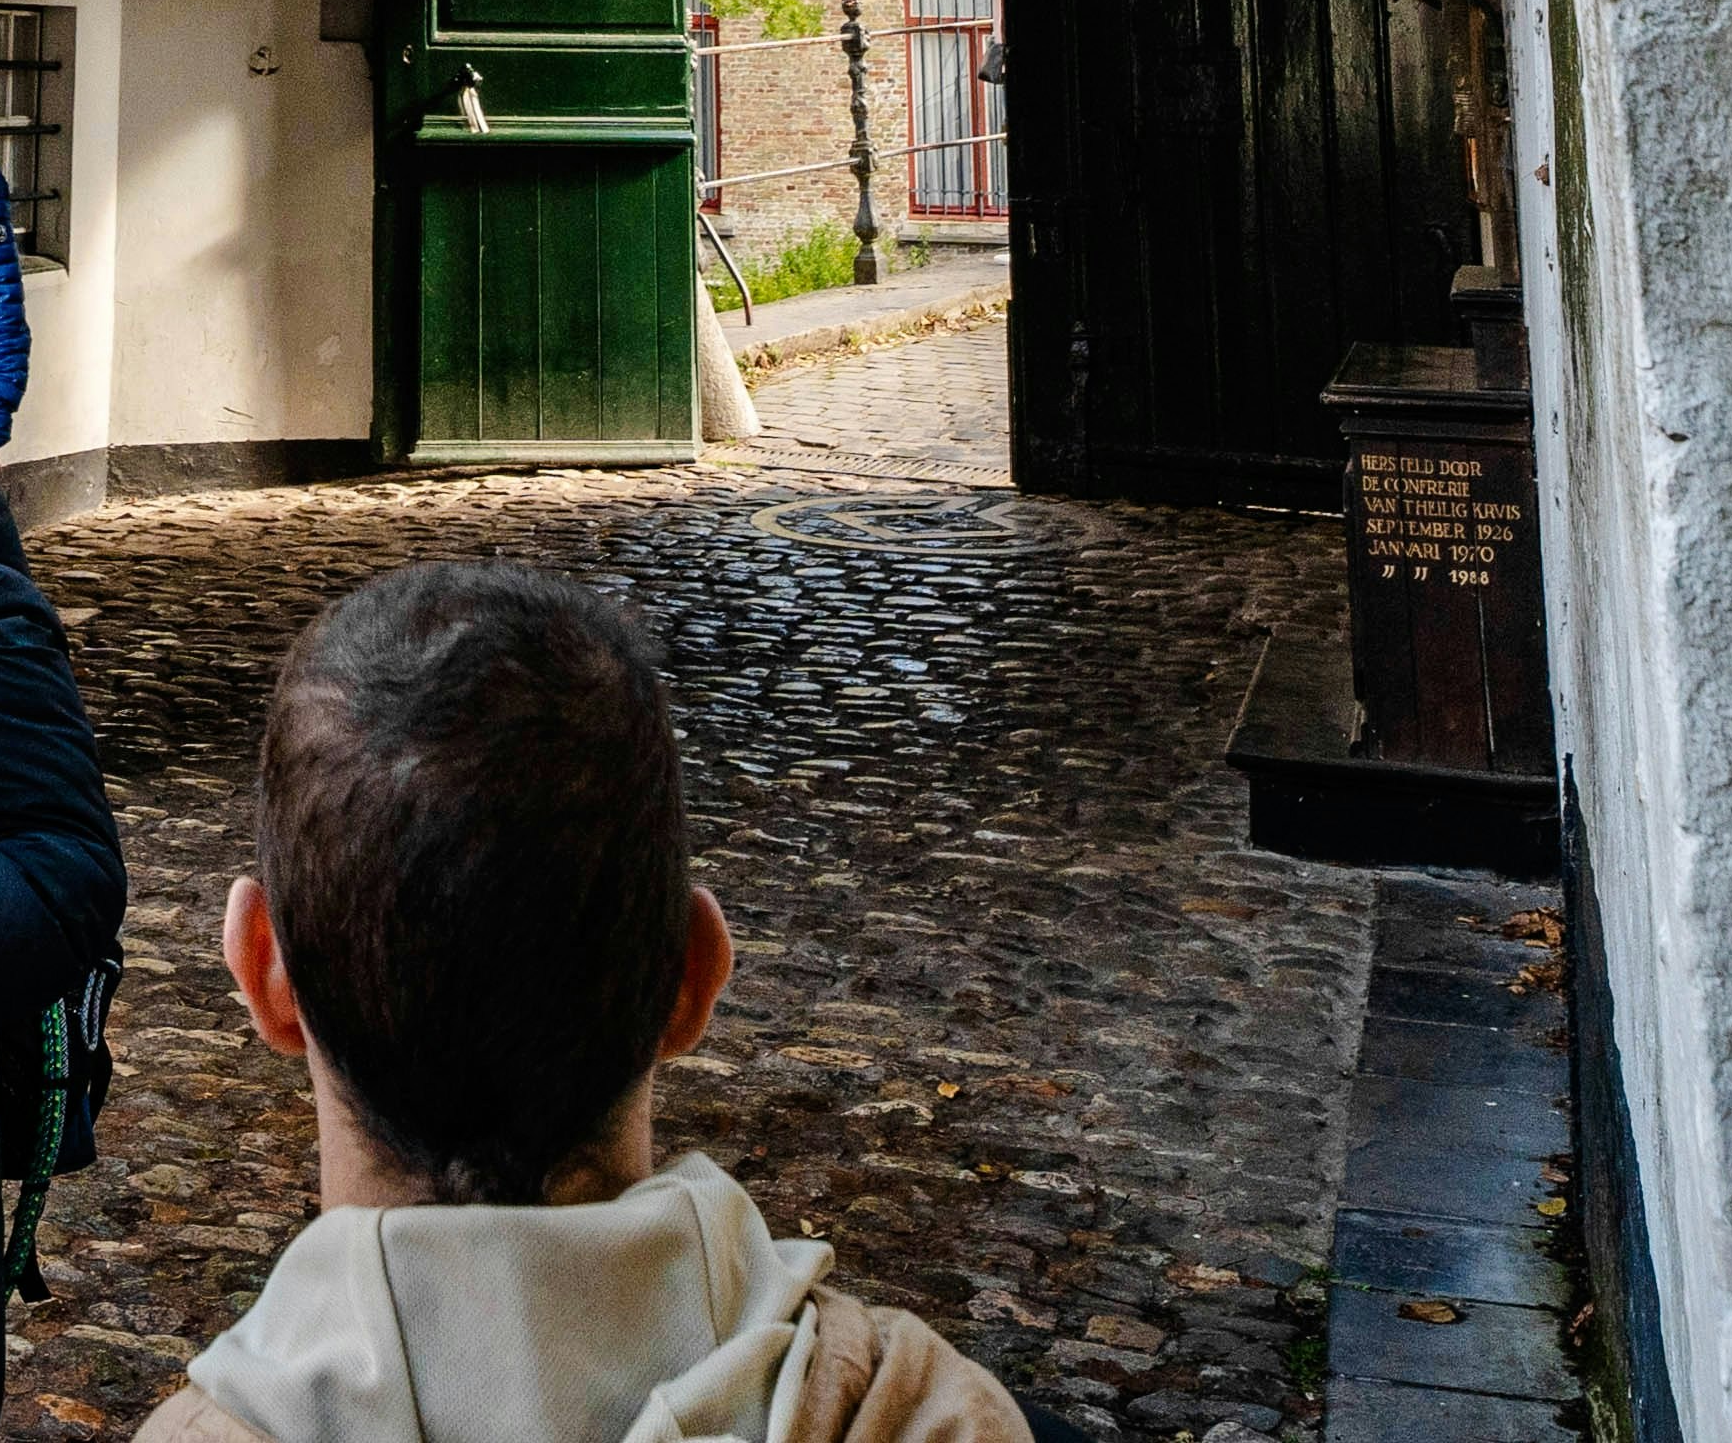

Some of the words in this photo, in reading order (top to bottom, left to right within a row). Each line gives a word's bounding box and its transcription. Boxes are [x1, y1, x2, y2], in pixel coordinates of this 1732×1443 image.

[1361, 454, 1434, 475] HERSTELD
[1439, 459, 1482, 476] DOOR
[1362, 476, 1381, 492] DE
[1384, 477, 1471, 497] CONFRERIE
[1364, 496, 1397, 513] VAN
[1366, 518, 1466, 539] SEPTEMBER
[1476, 524, 1513, 542] 1926
[1448, 545, 1494, 563] 1970
[1448, 569, 1490, 586] 1988
